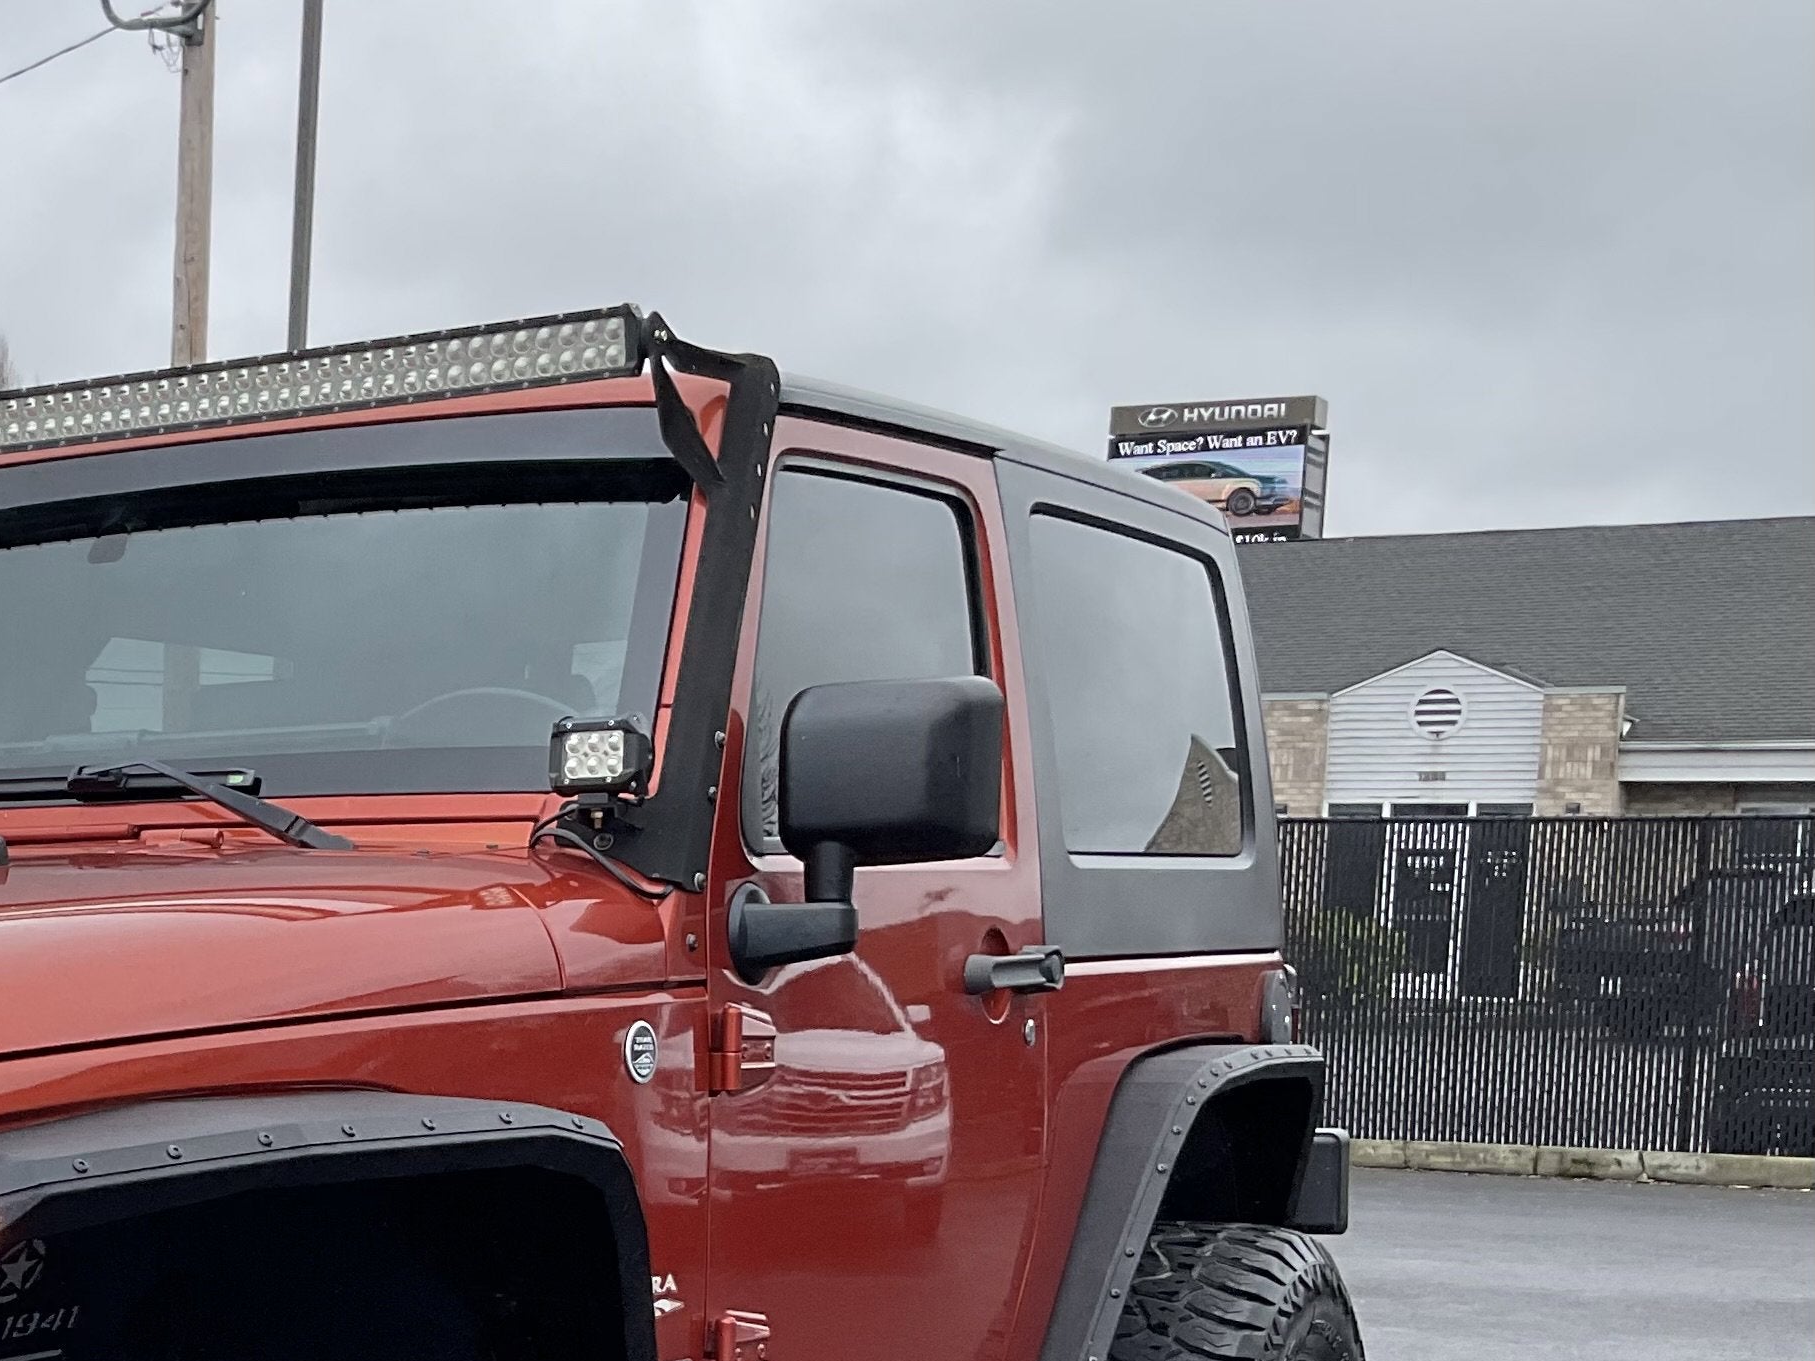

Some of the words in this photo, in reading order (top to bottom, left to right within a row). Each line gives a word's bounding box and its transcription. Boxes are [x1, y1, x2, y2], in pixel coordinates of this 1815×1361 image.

[1183, 403, 1286, 422] HYUNDAI
[1118, 441, 1154, 456] Want
[1157, 436, 1204, 456] Space?
[1207, 434, 1243, 449] Want
[1246, 435, 1264, 447] an
[1266, 429, 1298, 446] EV?
[1, 1305, 79, 1342] 1941
